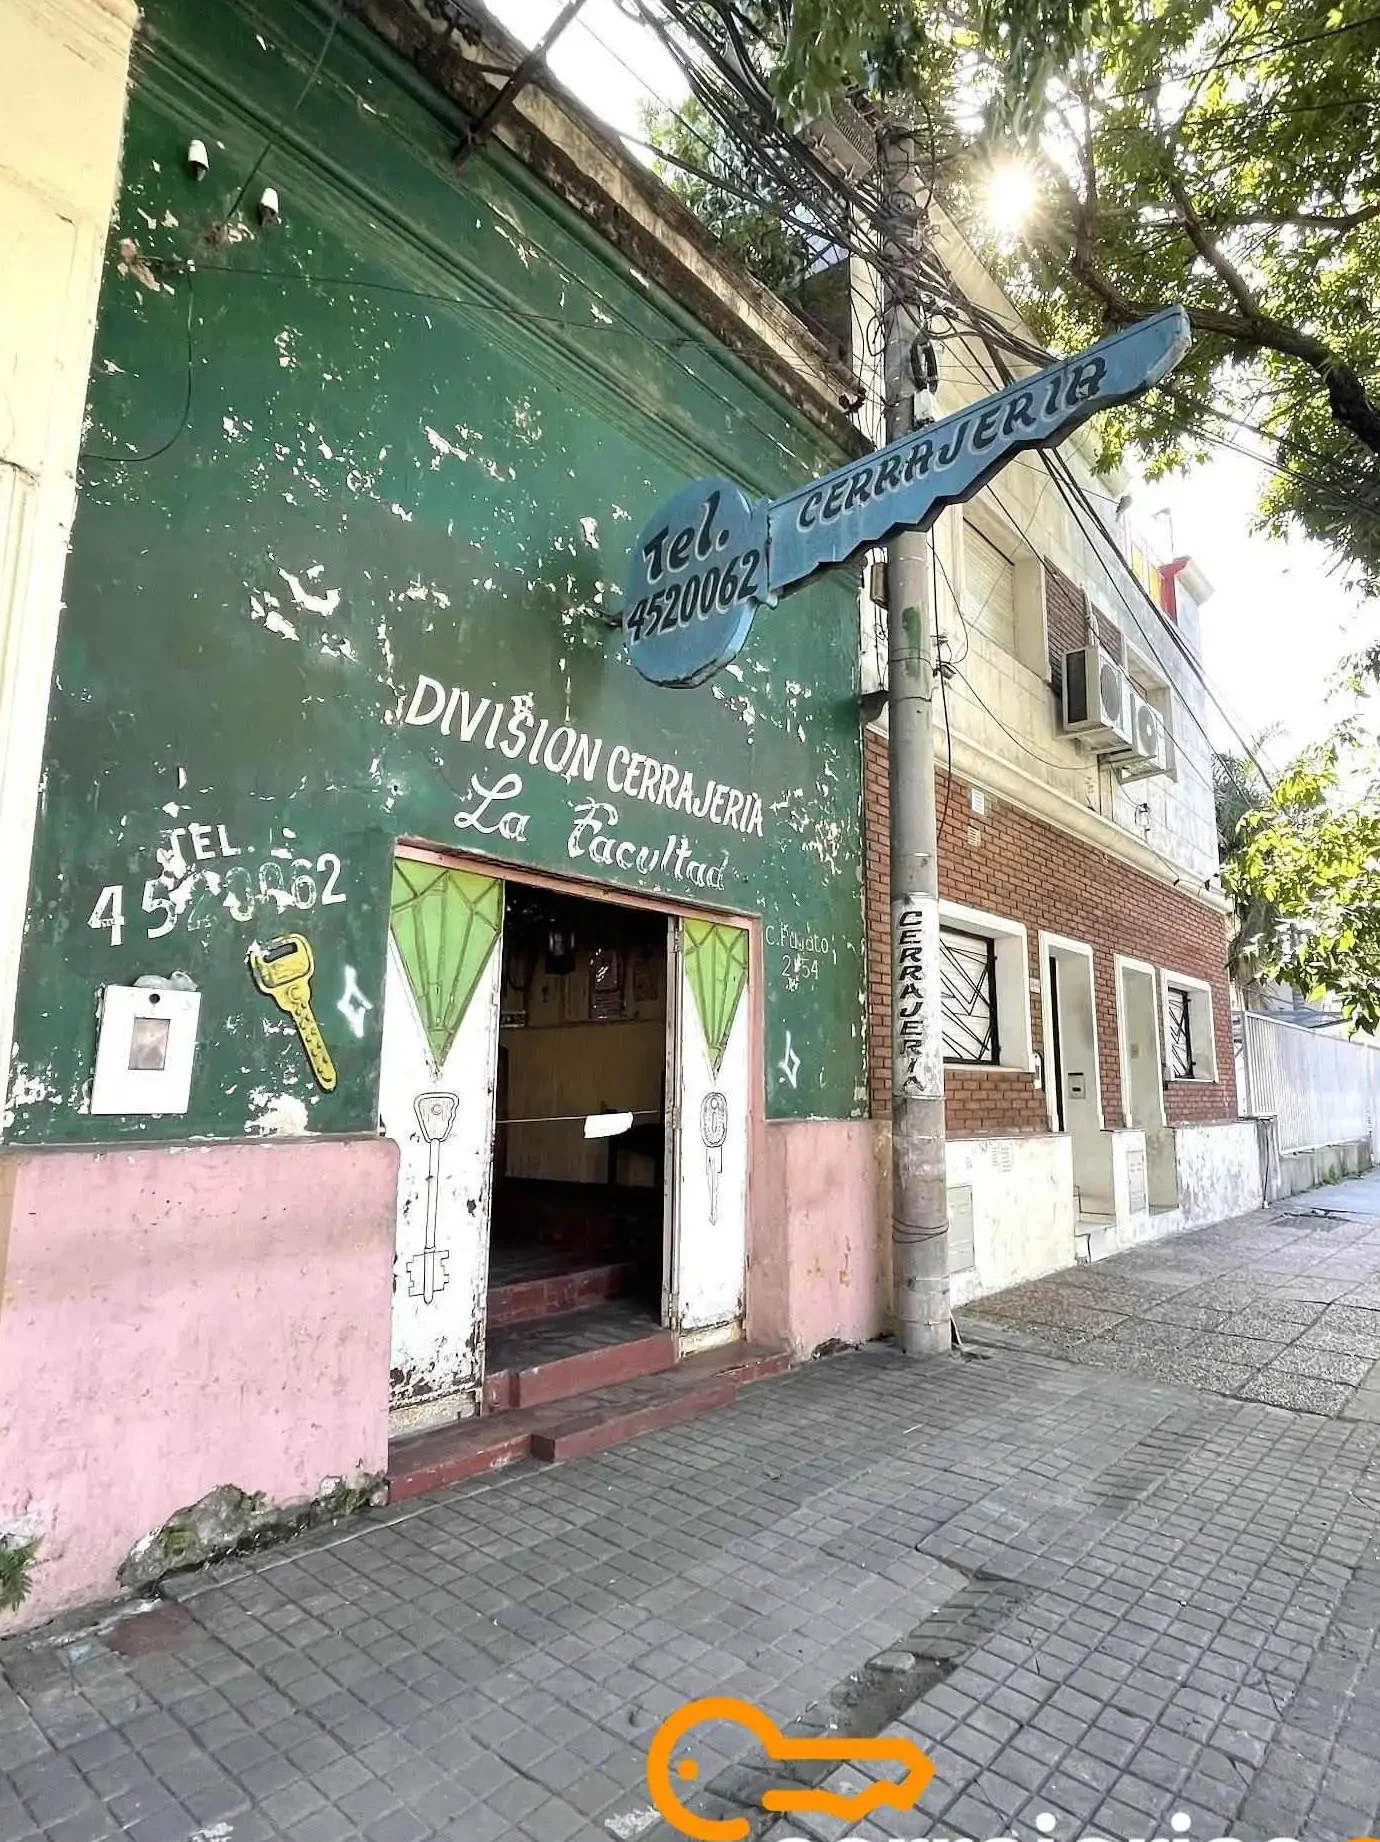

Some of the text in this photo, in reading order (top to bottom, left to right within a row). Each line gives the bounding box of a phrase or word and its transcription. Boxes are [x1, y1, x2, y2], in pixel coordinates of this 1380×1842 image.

[797, 357, 1107, 530] CERRAJERIA
[642, 490, 730, 584] Tel.
[627, 549, 760, 645] 4520062
[404, 674, 603, 783] DIVISION
[453, 773, 729, 890] La Facultad
[898, 910, 926, 1093] CERRAJERIA
